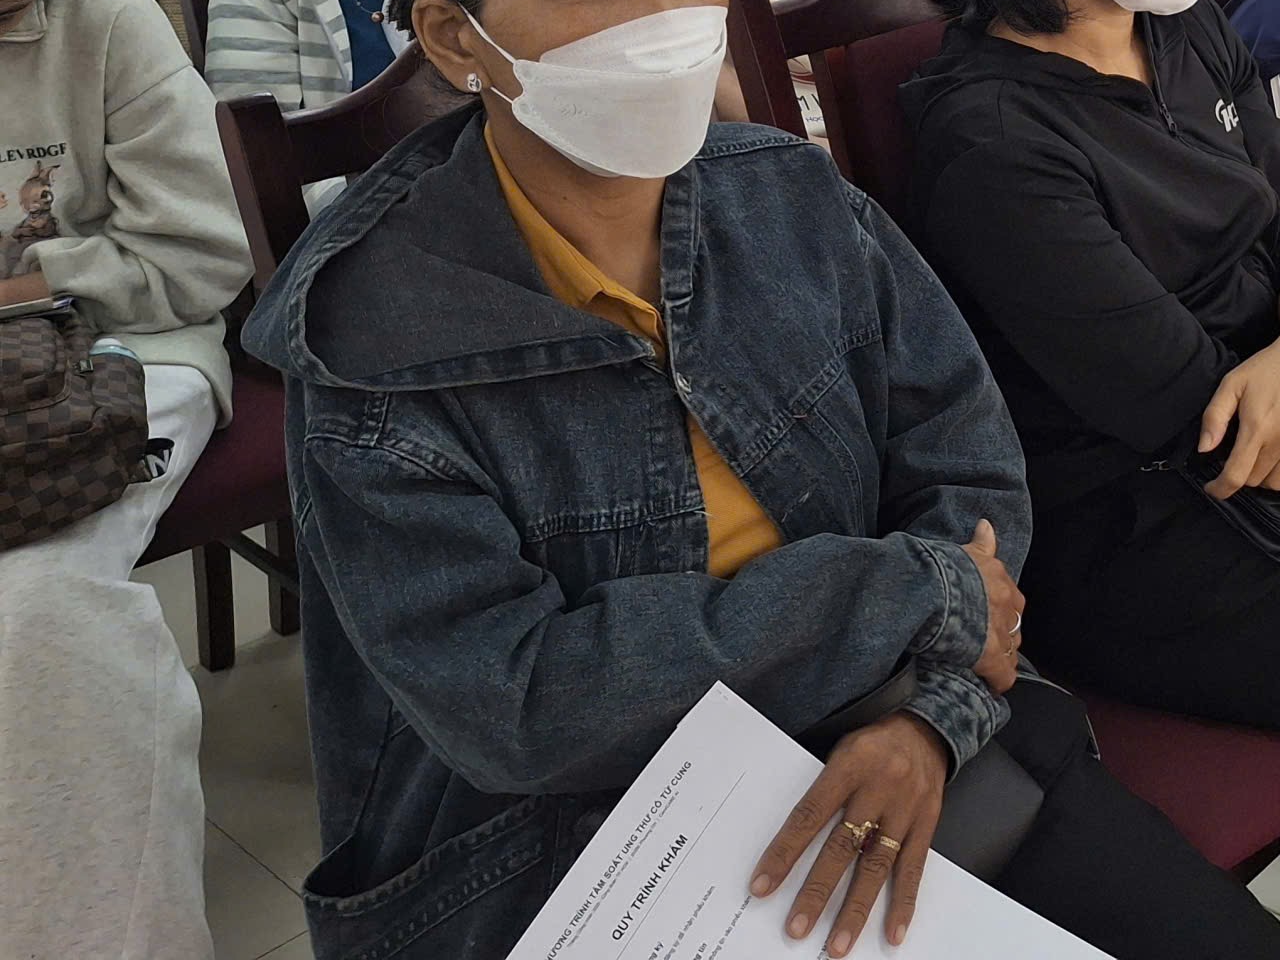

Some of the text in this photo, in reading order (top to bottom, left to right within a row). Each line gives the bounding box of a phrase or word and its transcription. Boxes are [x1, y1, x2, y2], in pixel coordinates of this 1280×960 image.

[621, 834, 638, 854] UNG
[671, 762, 691, 786] CUNG
[612, 911, 634, 941] QUY
[631, 872, 661, 909] TRÌNH
[658, 835, 688, 872] KHÁM
